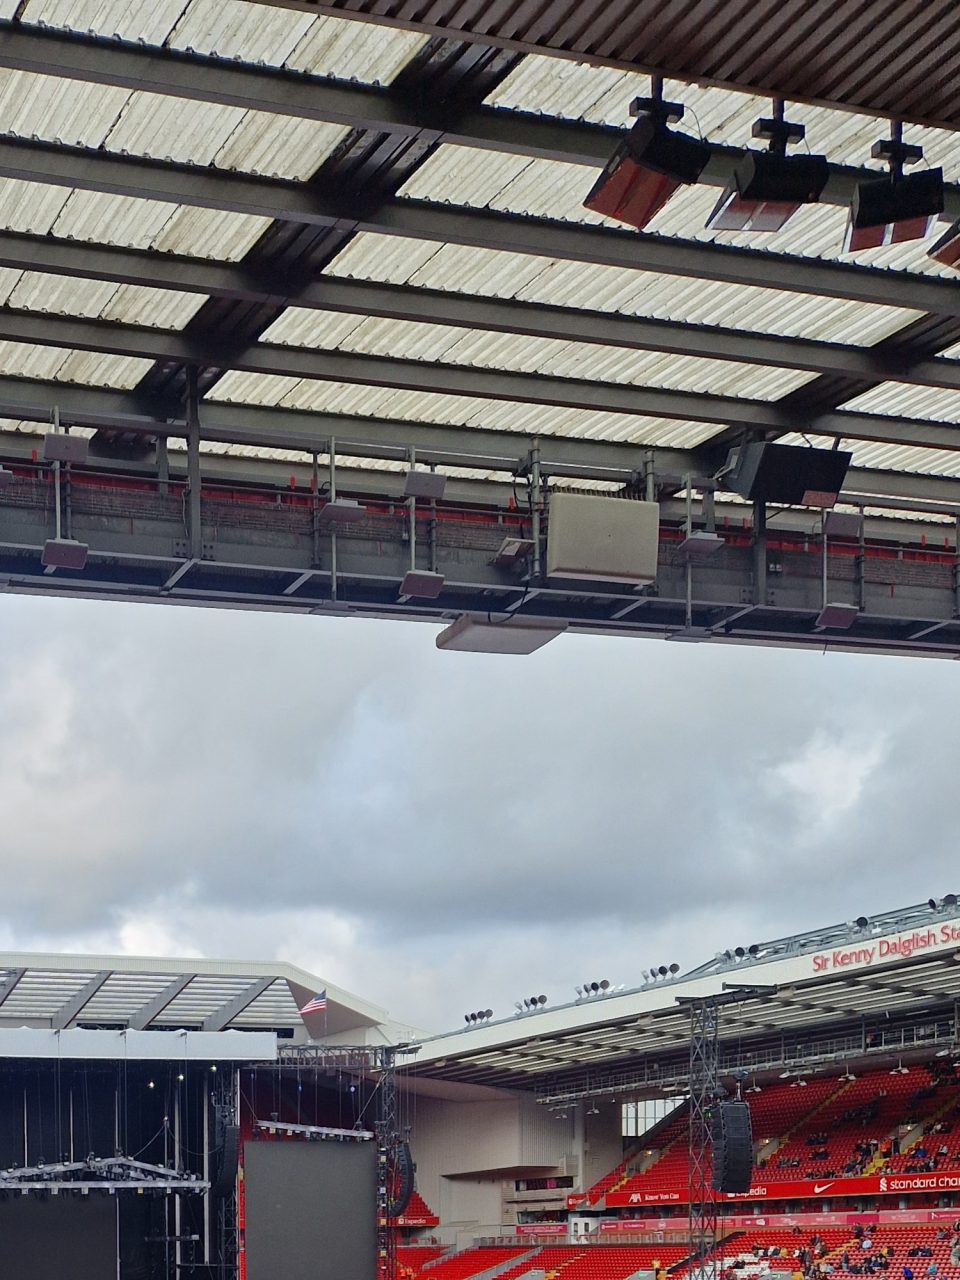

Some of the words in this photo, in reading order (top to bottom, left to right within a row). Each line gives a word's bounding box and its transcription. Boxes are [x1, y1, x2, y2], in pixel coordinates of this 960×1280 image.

[812, 955, 830, 972] Sir
[832, 945, 876, 968] Kenny
[878, 930, 938, 958] Dalglish
[889, 1177, 936, 1190] standard
